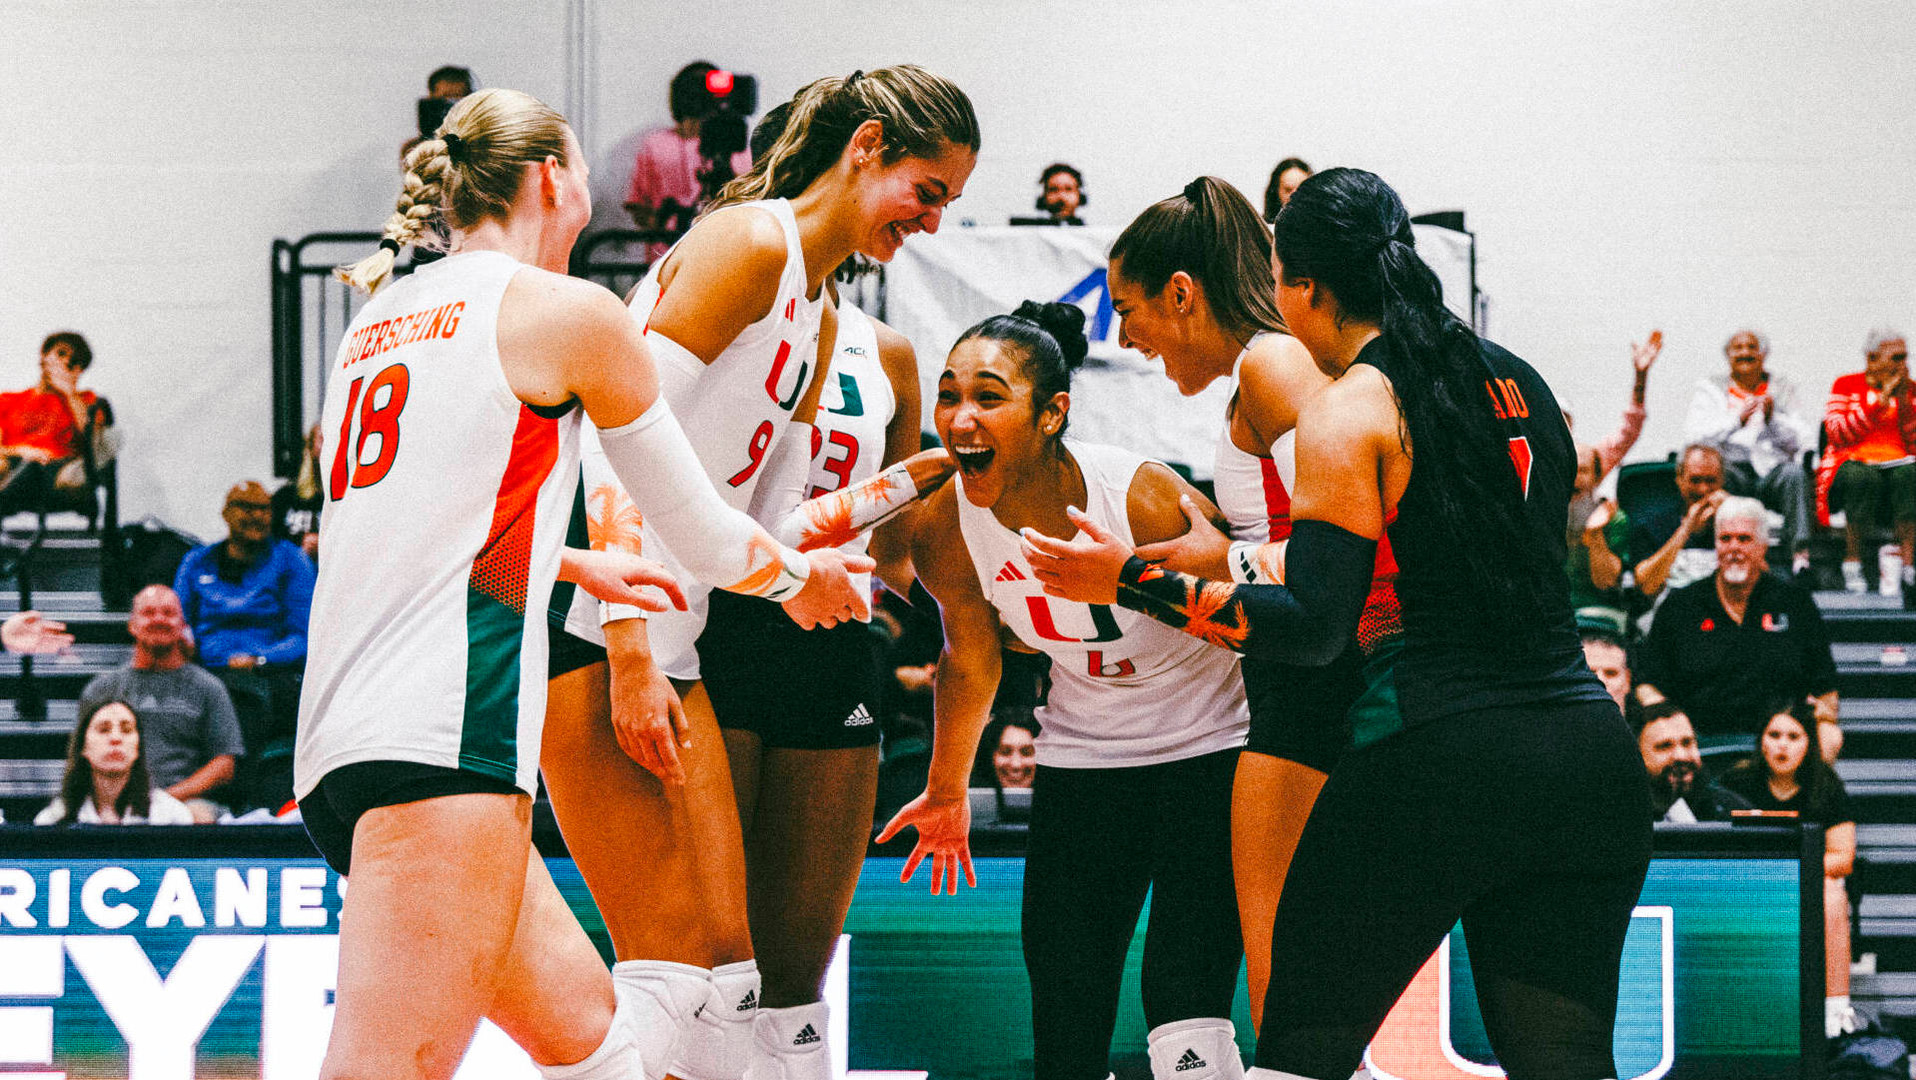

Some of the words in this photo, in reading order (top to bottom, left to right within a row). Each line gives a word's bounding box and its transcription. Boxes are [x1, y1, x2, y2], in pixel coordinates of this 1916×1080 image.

[343, 301, 466, 369] GUERSCHING
[330, 362, 410, 502] 18
[727, 420, 774, 488] 9
[844, 717, 873, 727] adidas
[0, 867, 347, 929] RICANE
[793, 1035, 821, 1046] adidas
[1175, 1061, 1207, 1071] adidas
